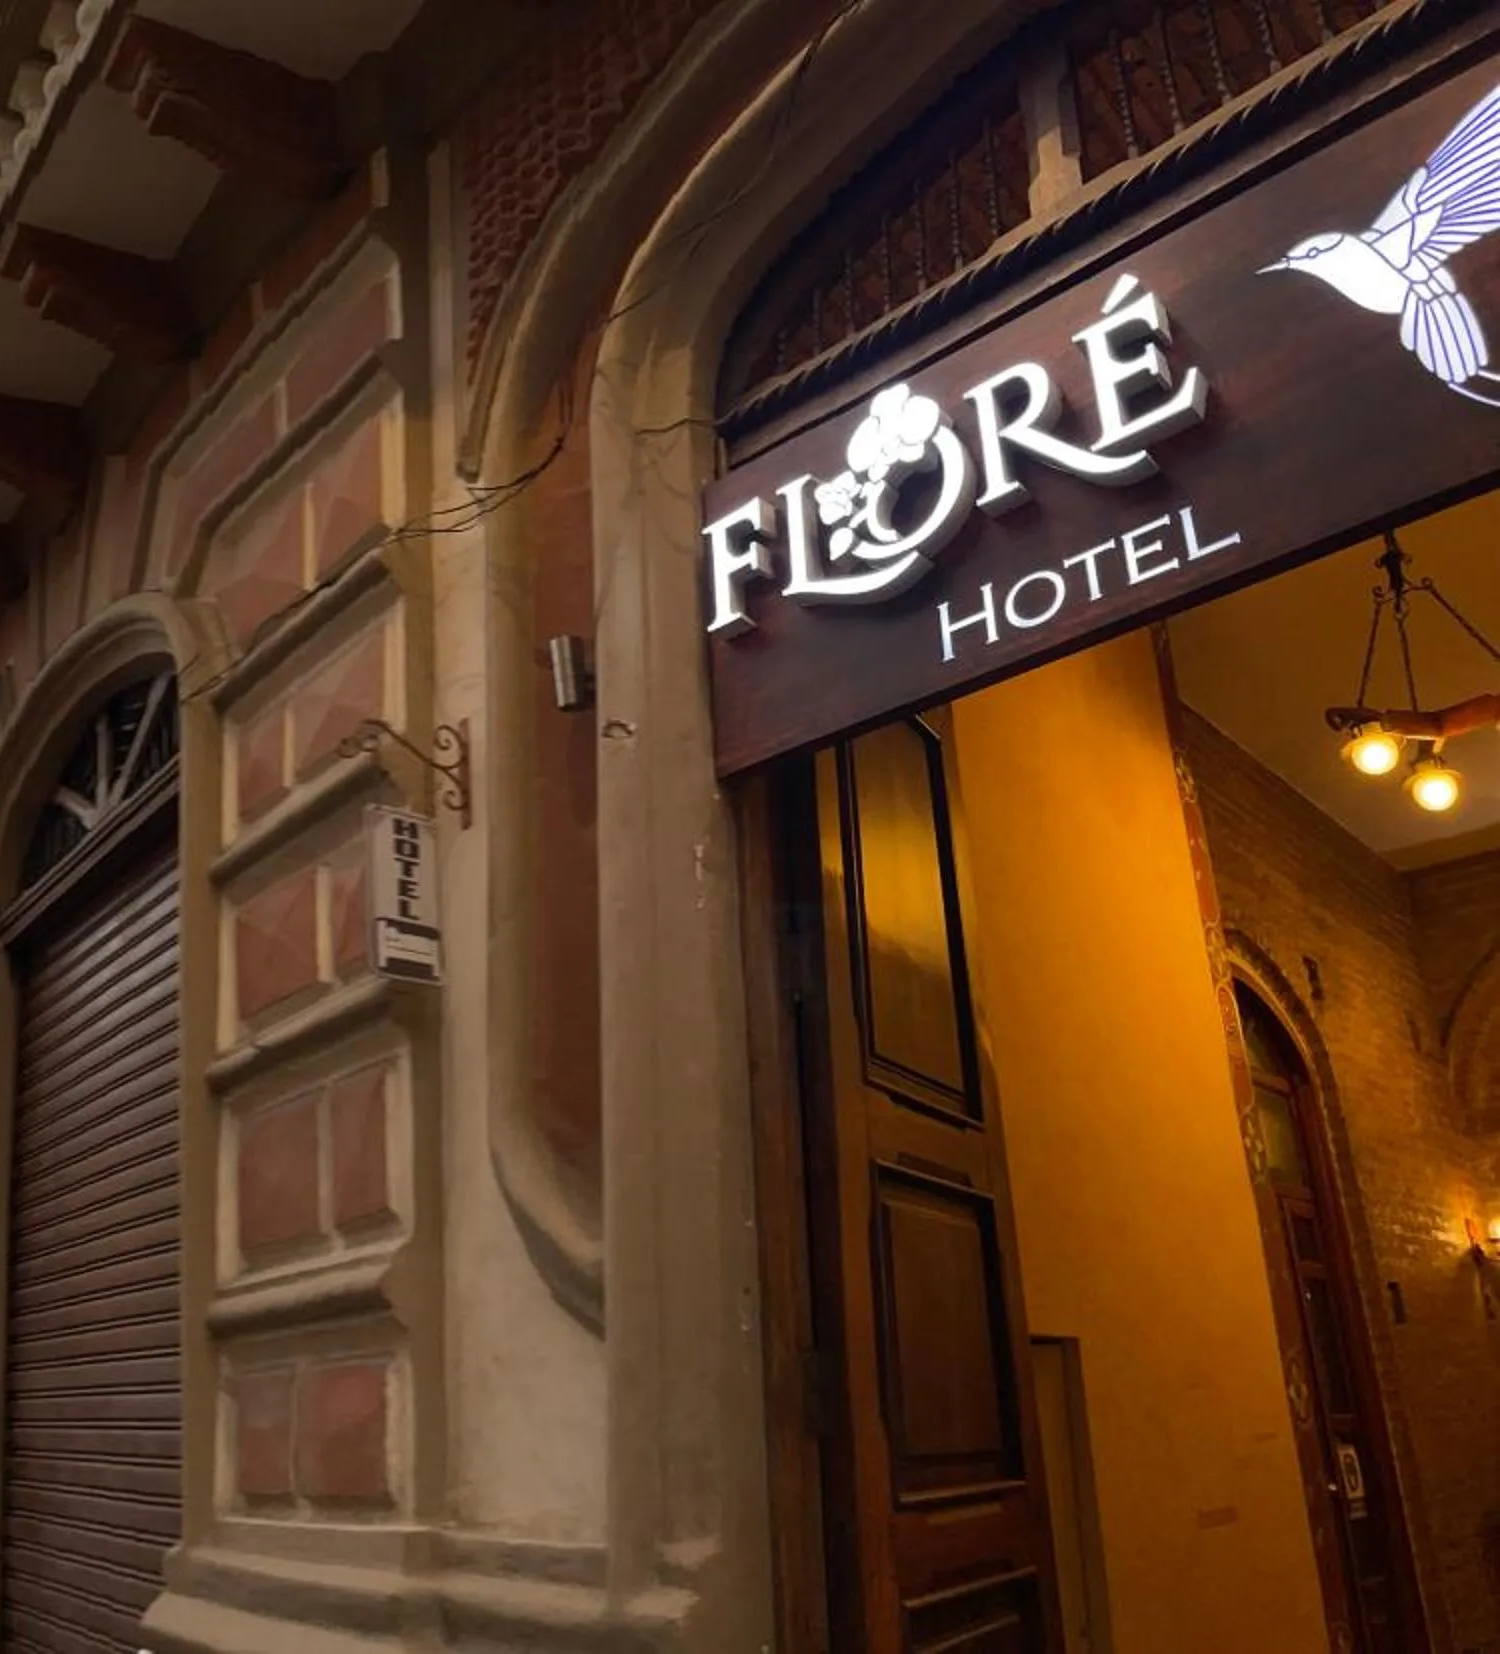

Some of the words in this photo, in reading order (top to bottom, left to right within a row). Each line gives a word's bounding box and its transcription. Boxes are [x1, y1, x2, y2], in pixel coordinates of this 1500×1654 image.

[703, 273, 1208, 637] FLORÉ
[934, 506, 1242, 663] HOTEL
[392, 817, 421, 921] HOTEL
